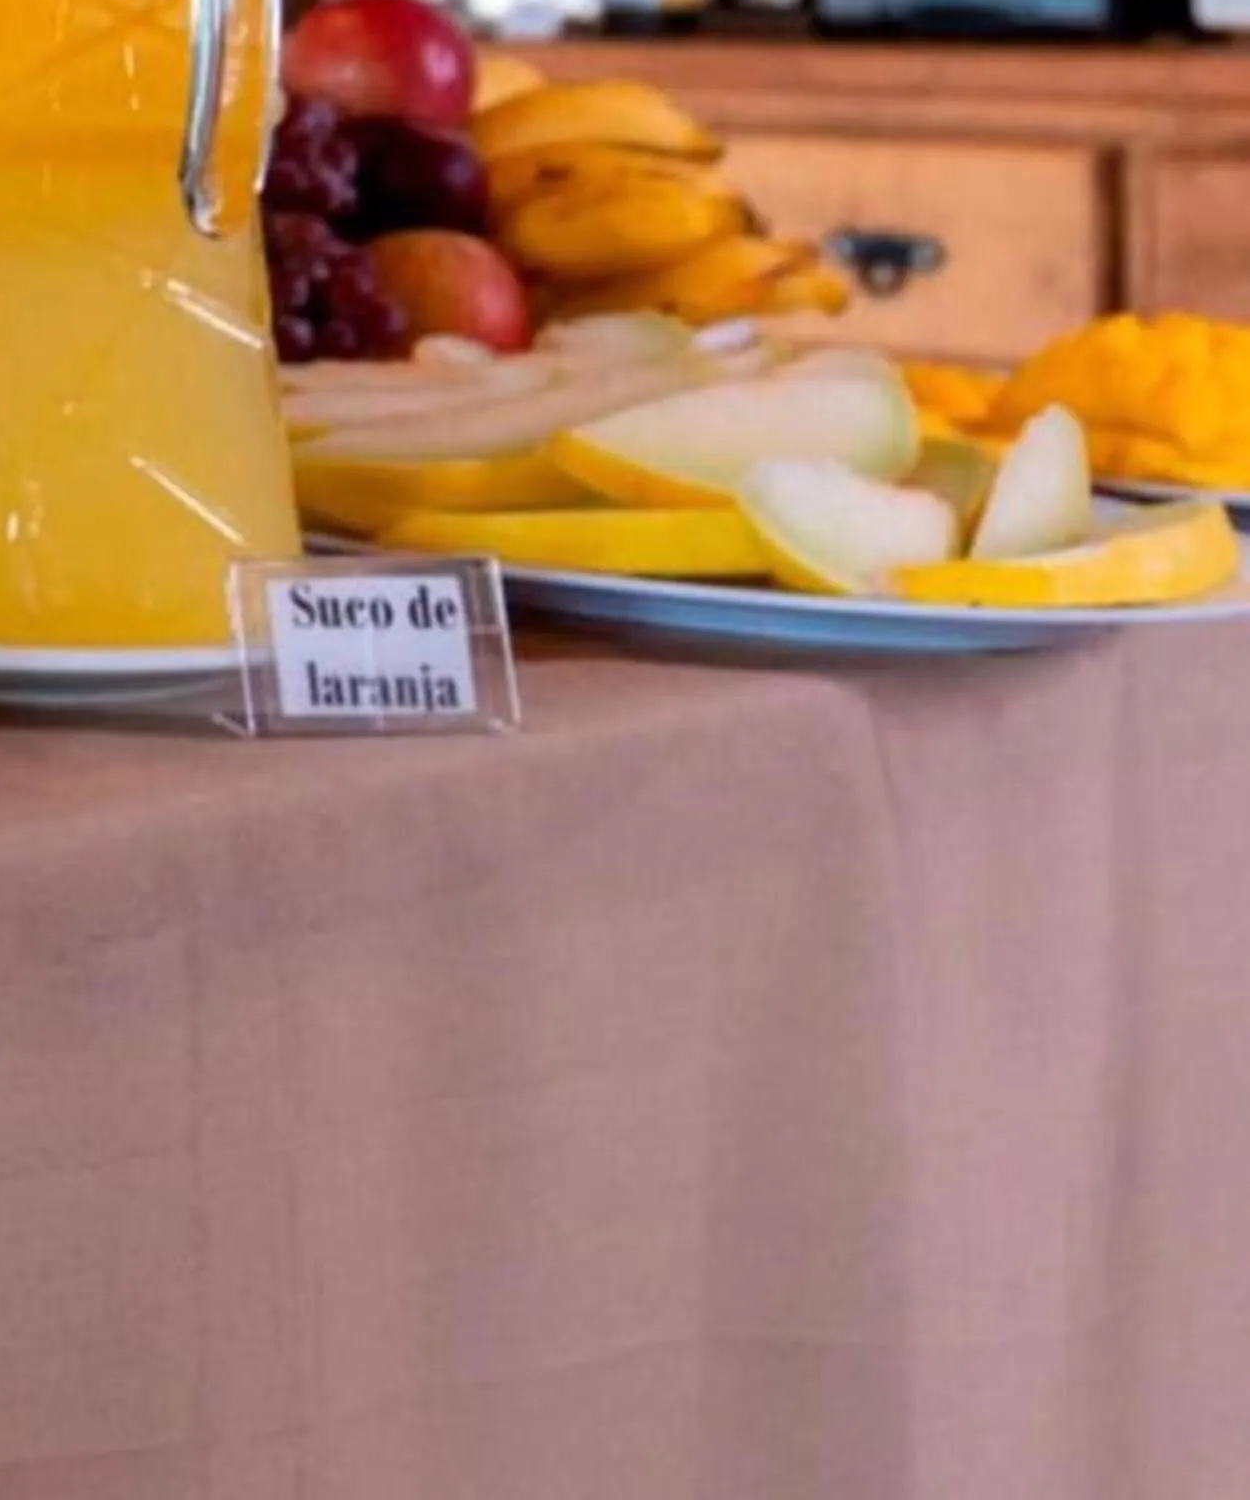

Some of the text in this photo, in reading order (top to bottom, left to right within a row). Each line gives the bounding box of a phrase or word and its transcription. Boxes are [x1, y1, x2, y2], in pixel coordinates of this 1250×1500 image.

[290, 583, 458, 630] Suco de
[306, 660, 460, 712] laranja
